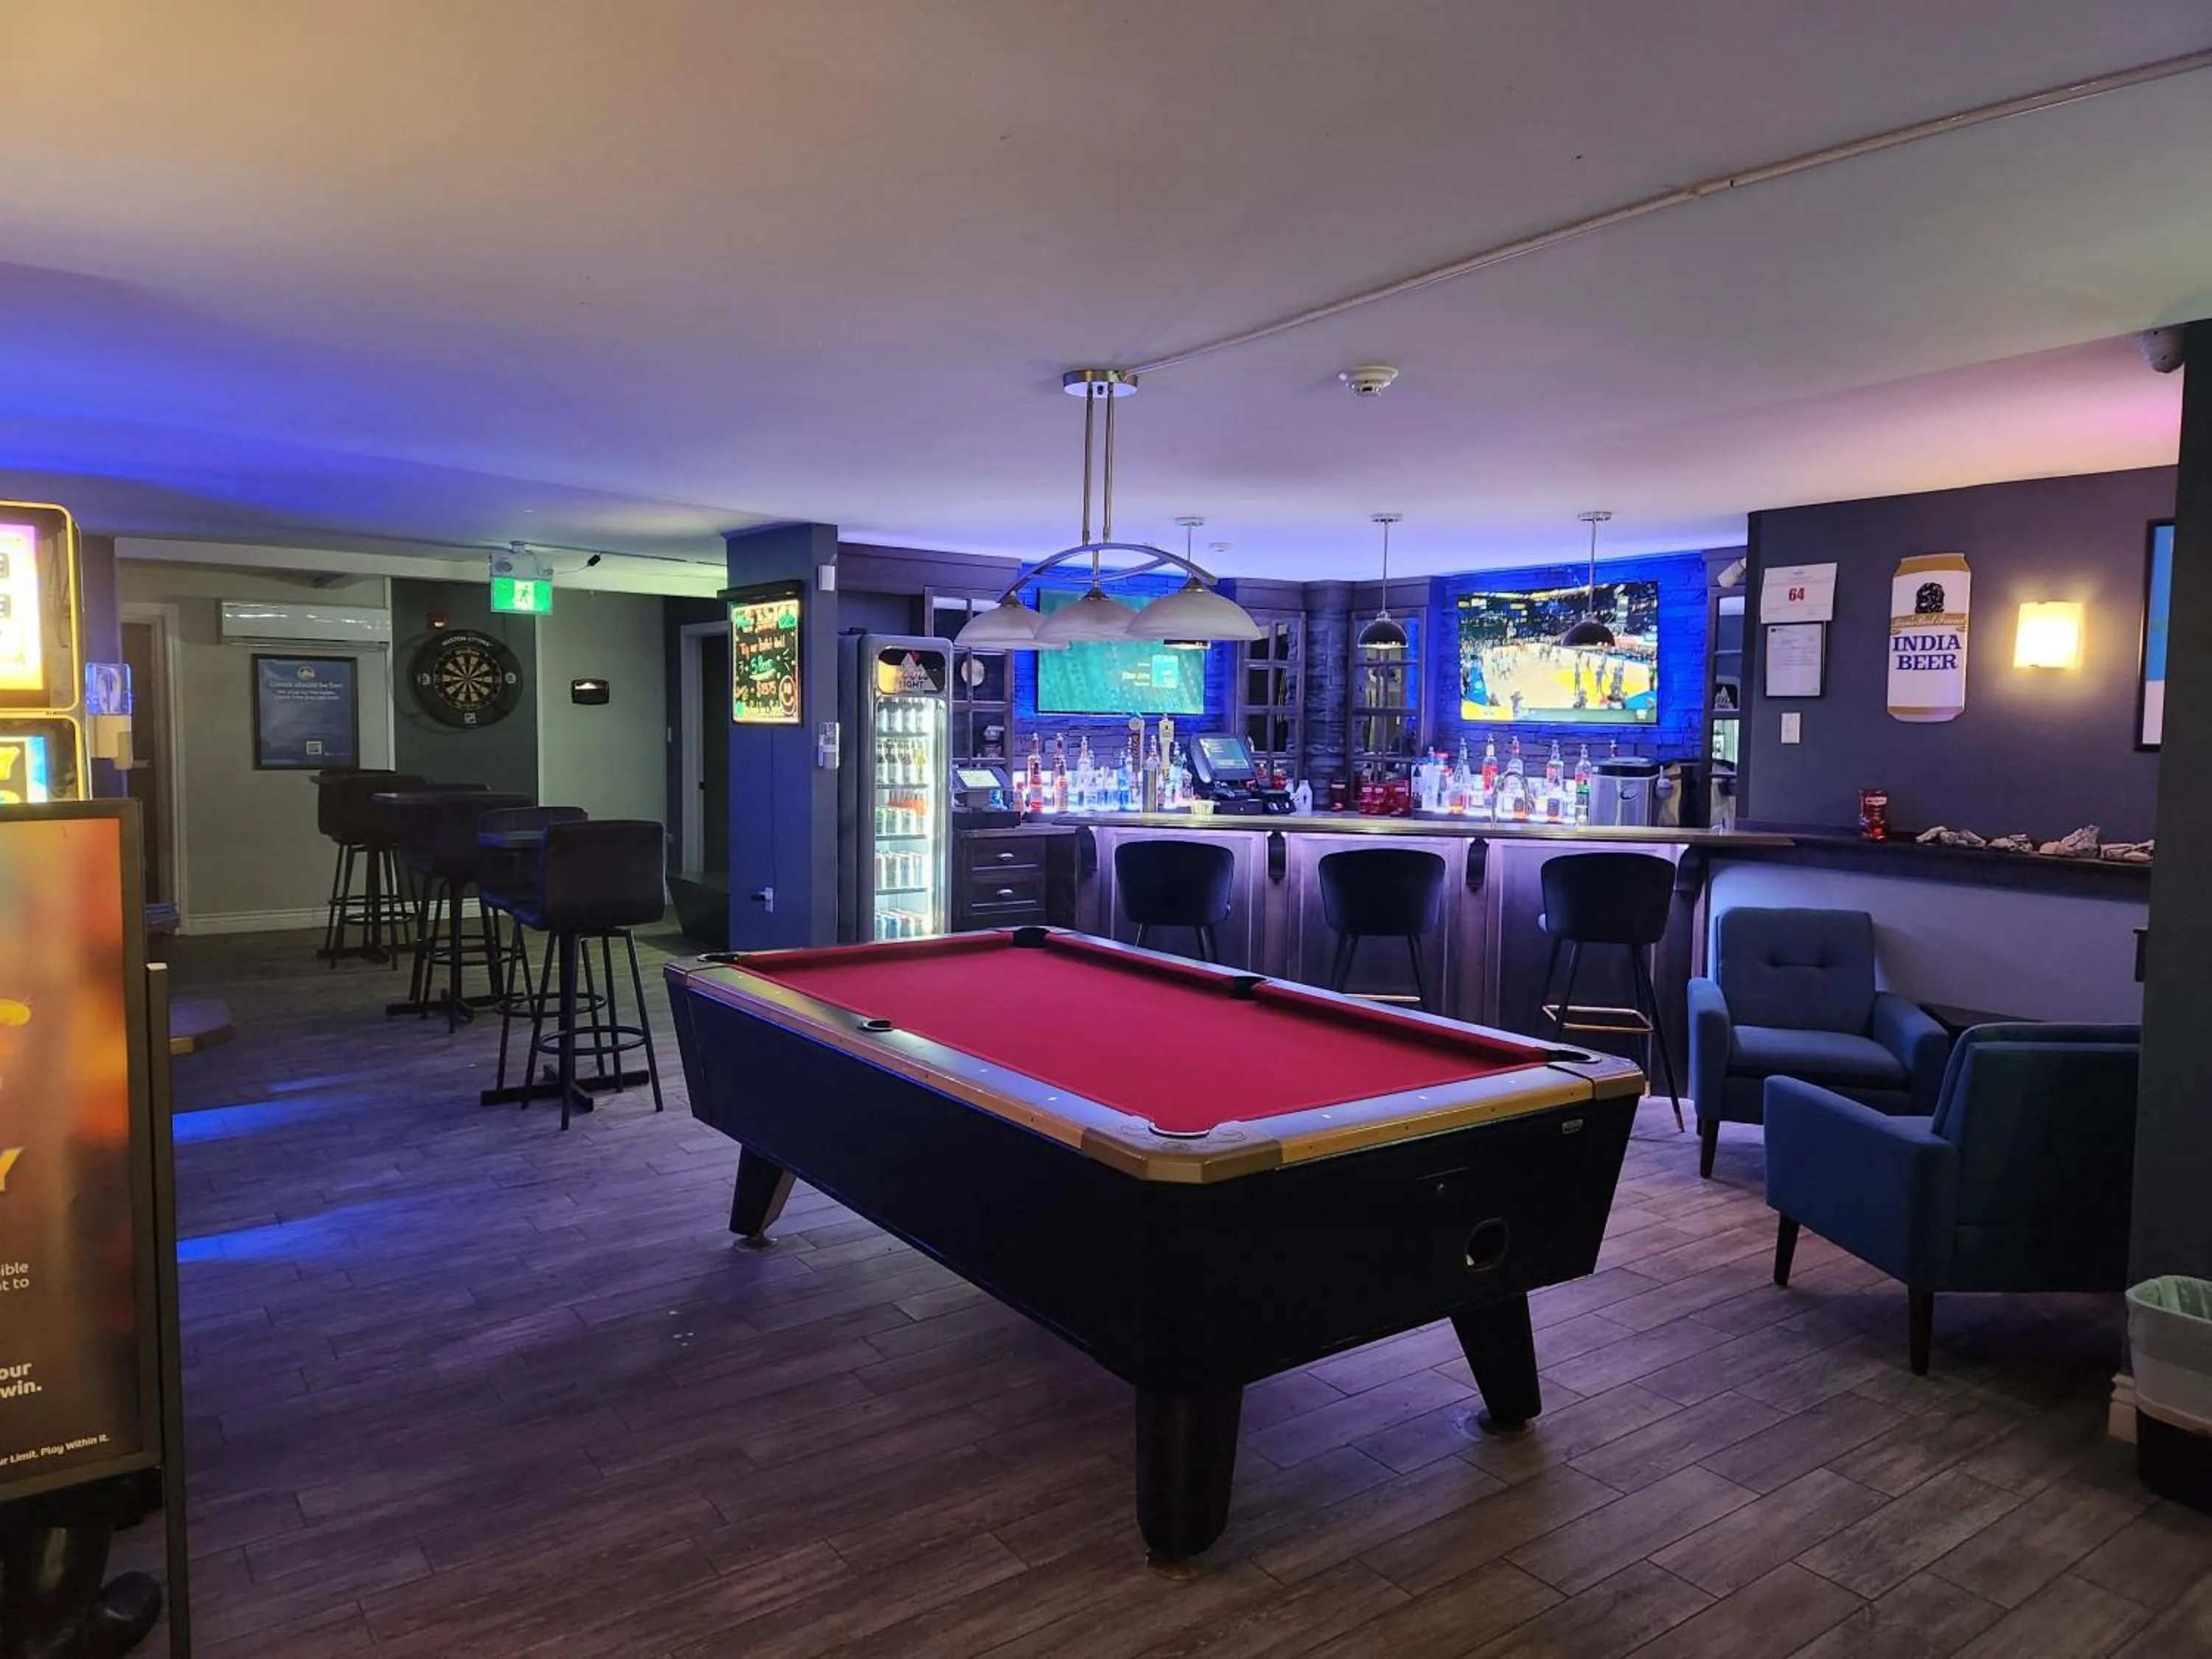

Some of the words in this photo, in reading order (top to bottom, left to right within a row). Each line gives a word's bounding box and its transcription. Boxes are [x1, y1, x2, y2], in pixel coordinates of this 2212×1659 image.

[1788, 588, 1805, 602] 64
[1892, 635, 1962, 651] INDIA
[1896, 654, 1958, 670] BEER
[13, 1278, 29, 1290] to
[0, 1380, 42, 1398] win.
[10, 1450, 39, 1464] Limit.
[41, 1444, 65, 1456] Play
[65, 1437, 97, 1450] Within
